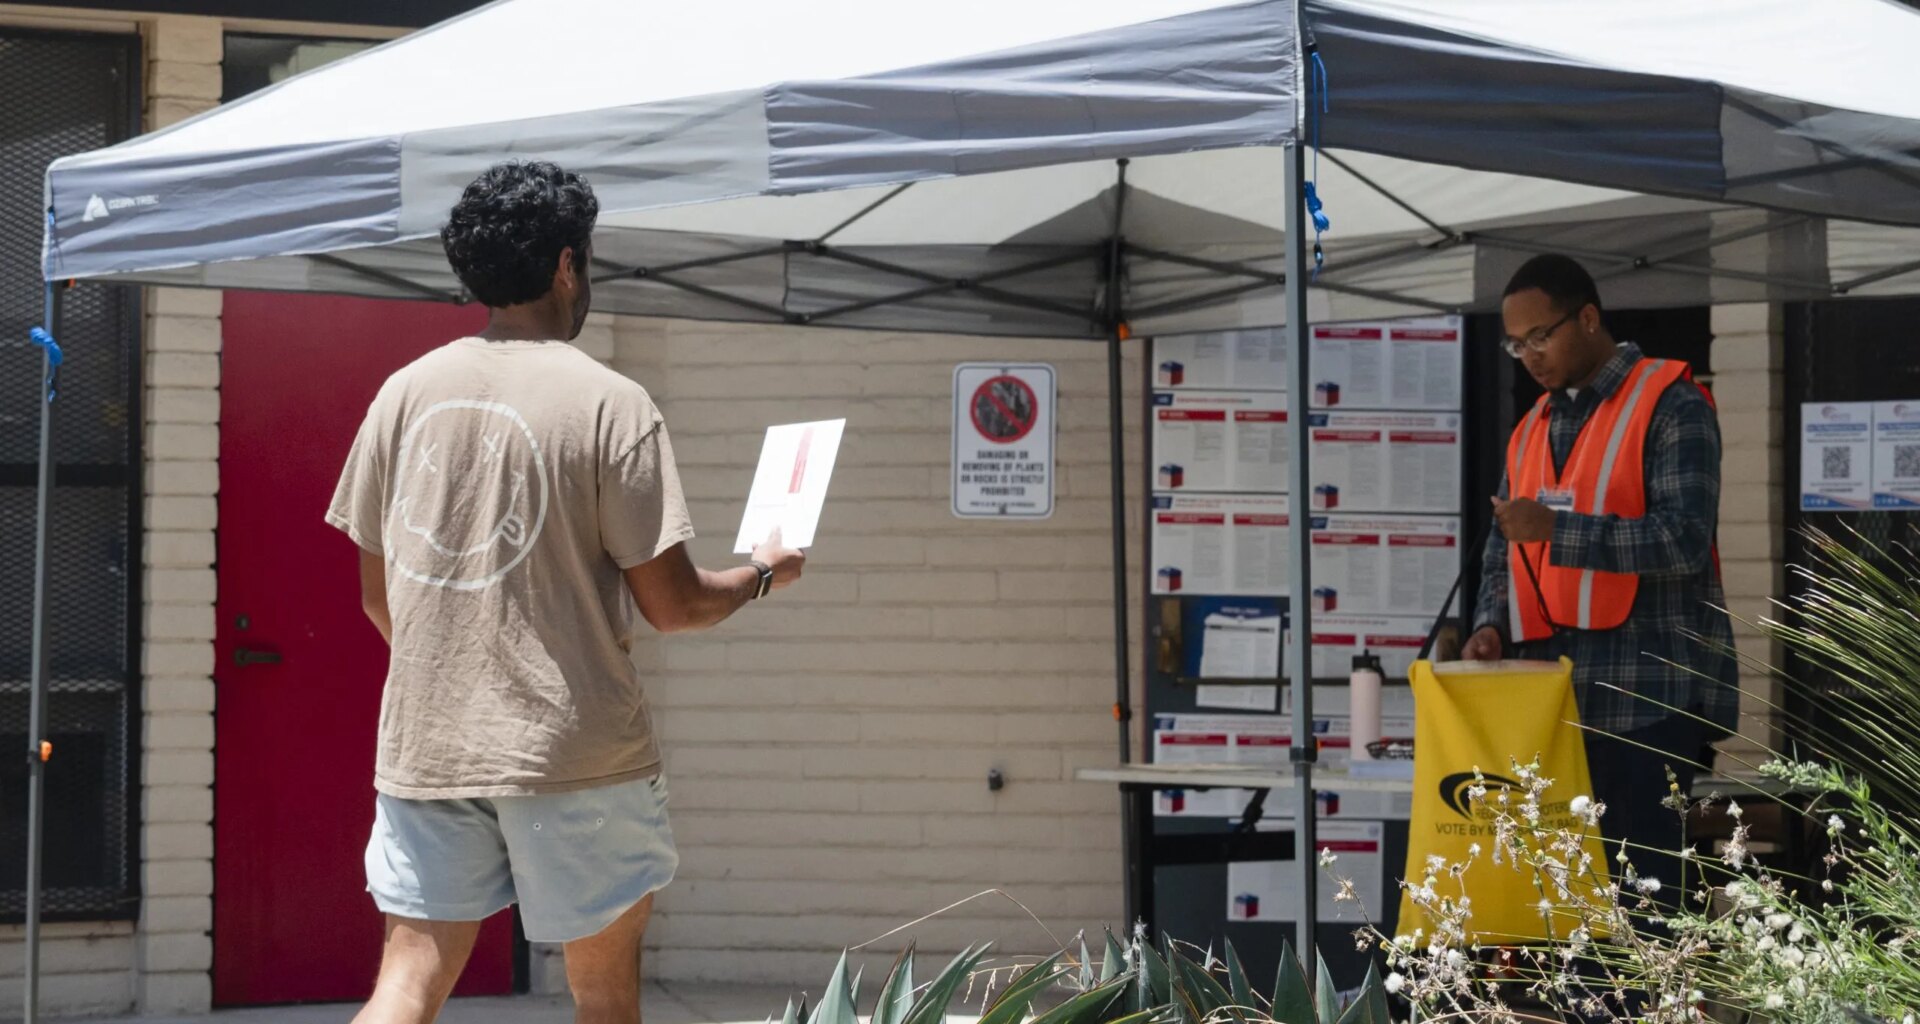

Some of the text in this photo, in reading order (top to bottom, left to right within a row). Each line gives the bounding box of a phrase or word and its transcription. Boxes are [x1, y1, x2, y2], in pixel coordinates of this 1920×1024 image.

[977, 450, 1029, 459] DAMAGING OR
[962, 462, 1044, 472] REMOVING OF PLANTS
[961, 474, 1045, 485] OR ROCKS IS STRICTLY
[980, 486, 1025, 496] PROHIBITED
[1435, 822, 1467, 836] VOTE
[1469, 824, 1485, 837] BY
[1556, 816, 1578, 830] BAG
